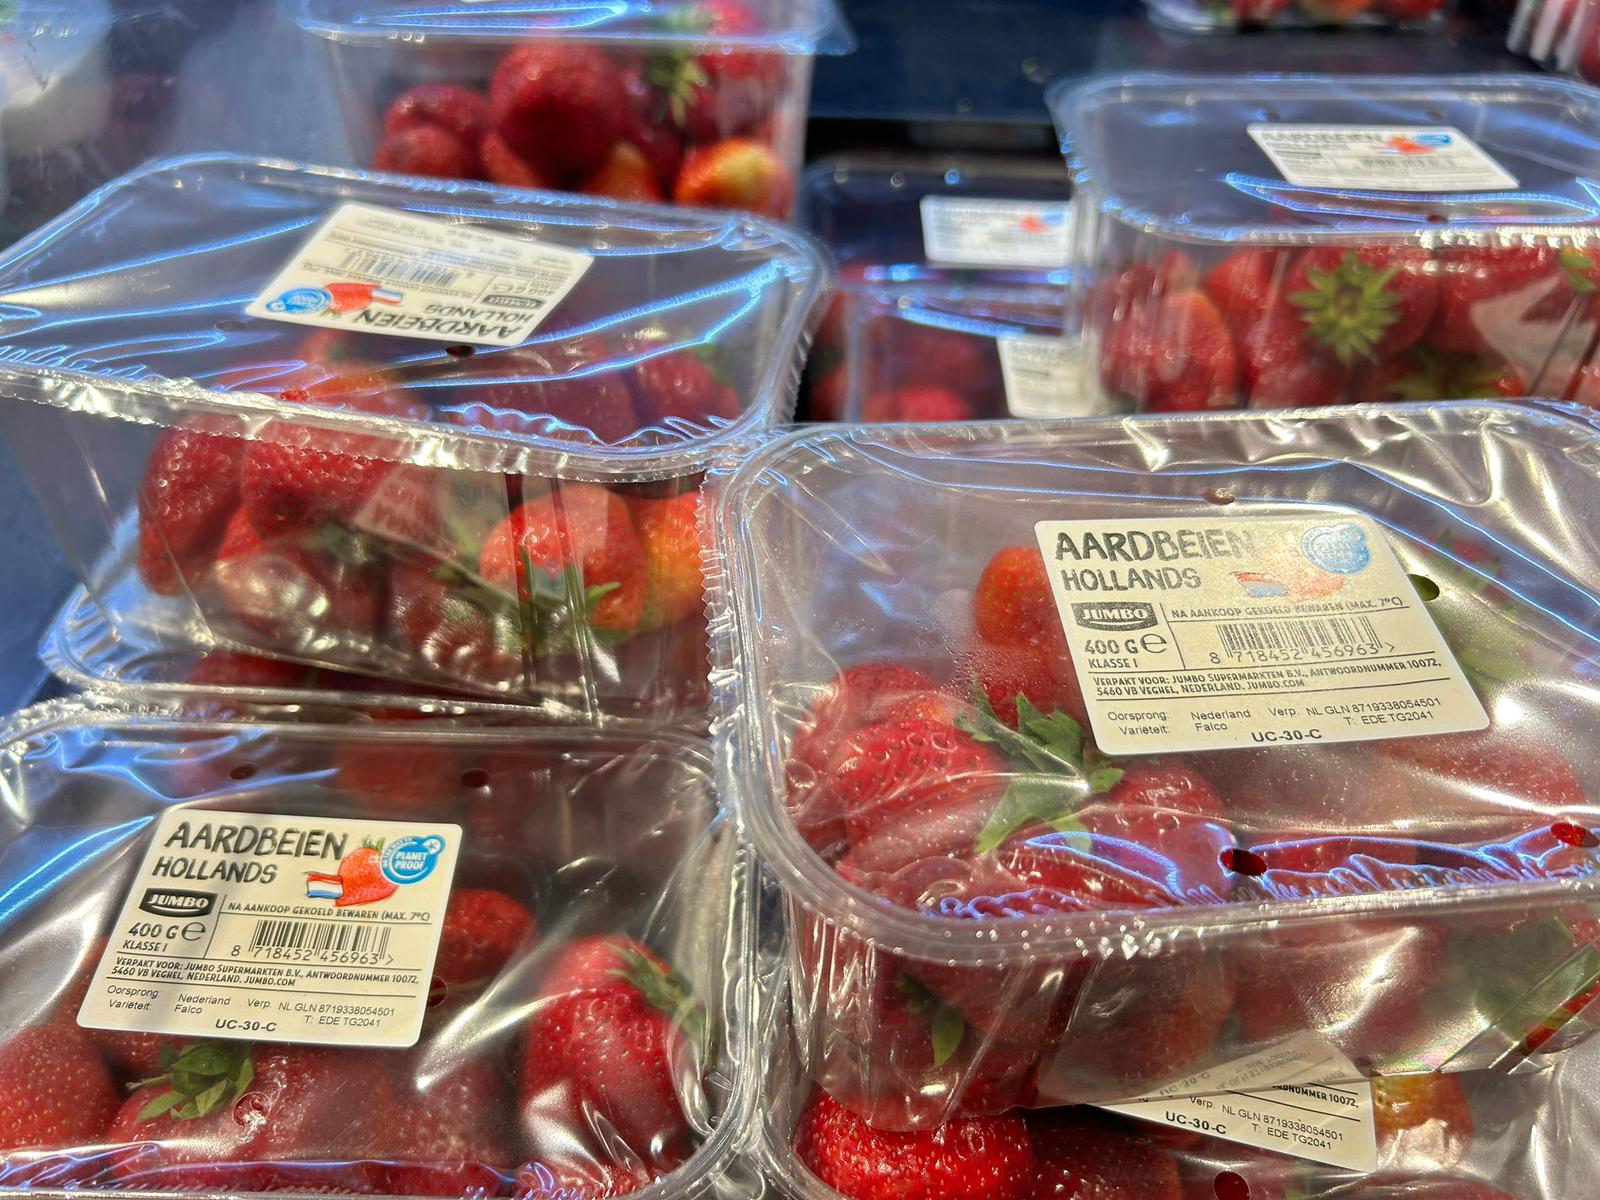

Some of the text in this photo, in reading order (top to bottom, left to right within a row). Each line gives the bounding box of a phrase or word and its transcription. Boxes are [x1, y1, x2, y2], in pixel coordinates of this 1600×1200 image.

[352, 310, 523, 339] AARDBEIEN
[1055, 528, 1257, 562] AARDBEIEN
[1060, 567, 1201, 591] HOLLANDS
[1081, 607, 1149, 621] JUMBO
[1171, 608, 1187, 619] NA
[1190, 607, 1241, 619] AANKOOP
[1345, 599, 1377, 611] (MAX.
[1084, 639, 1119, 655] 400
[1124, 639, 1139, 654] G
[1209, 642, 1379, 664] 8 718452 456963
[1088, 658, 1131, 669] KLASSE
[1093, 677, 1136, 687] VERPAKT
[1138, 676, 1169, 685] VOOR:
[1171, 674, 1205, 684] JUMBO
[1209, 669, 1284, 682] SUPERMARKTEN
[1310, 660, 1406, 677] ANTWOORDNUMMER
[1407, 657, 1442, 670] 10072,
[1097, 679, 1304, 696] 5460 VB VEGHEL, NEDERLAND. JUMBO.COM
[1191, 709, 1251, 721] Nederland
[1306, 706, 1323, 716] NL
[1324, 705, 1350, 715] GLN
[1352, 697, 1441, 713] 8719338054501
[1343, 711, 1434, 726] T: EDE TG2041
[1195, 722, 1227, 733] Falco
[1252, 729, 1322, 742] UC-30-C
[164, 821, 349, 860] AARDBEIEN
[394, 860, 424, 870] PROOF
[396, 851, 428, 862] PLANET
[152, 856, 278, 884] HOLLANDS
[148, 894, 209, 909] JUMBO
[228, 902, 242, 911] NA
[243, 902, 290, 913] AANKOOP
[292, 906, 333, 916] GEKOELD
[336, 909, 379, 919] BEWAREN
[381, 910, 407, 921] (MAX.
[128, 922, 162, 938] 400
[166, 925, 180, 939] G
[122, 939, 162, 952] KLASSE
[231, 945, 380, 965] 8 718452 456963
[111, 966, 295, 987] 5460 VB VEGHEL, NEDERLAND. JUMBO.COM
[116, 956, 155, 968] VERPAKT
[156, 959, 183, 970] VOOR:
[183, 962, 215, 972] JUMBO
[217, 963, 283, 976] SUPERMARKTEN
[306, 970, 390, 983] ANTWOORDNUMMER
[392, 975, 419, 985] 10072,
[178, 993, 231, 1005] Nederland
[247, 997, 395, 1016] Verp. NL GLN 8719338054501
[174, 1004, 203, 1015] Falco
[215, 1018, 277, 1032] UC-30-C
[304, 1015, 381, 1027] T: EDE TG2041
[1329, 1093, 1360, 1109] 10072,
[1165, 1111, 1226, 1135] UC-30-C
[1222, 1104, 1235, 1116] NL
[1238, 1108, 1261, 1121] GLN
[1263, 1115, 1343, 1141] 8719338054501
[1251, 1122, 1331, 1150] T: EDE TG2041
